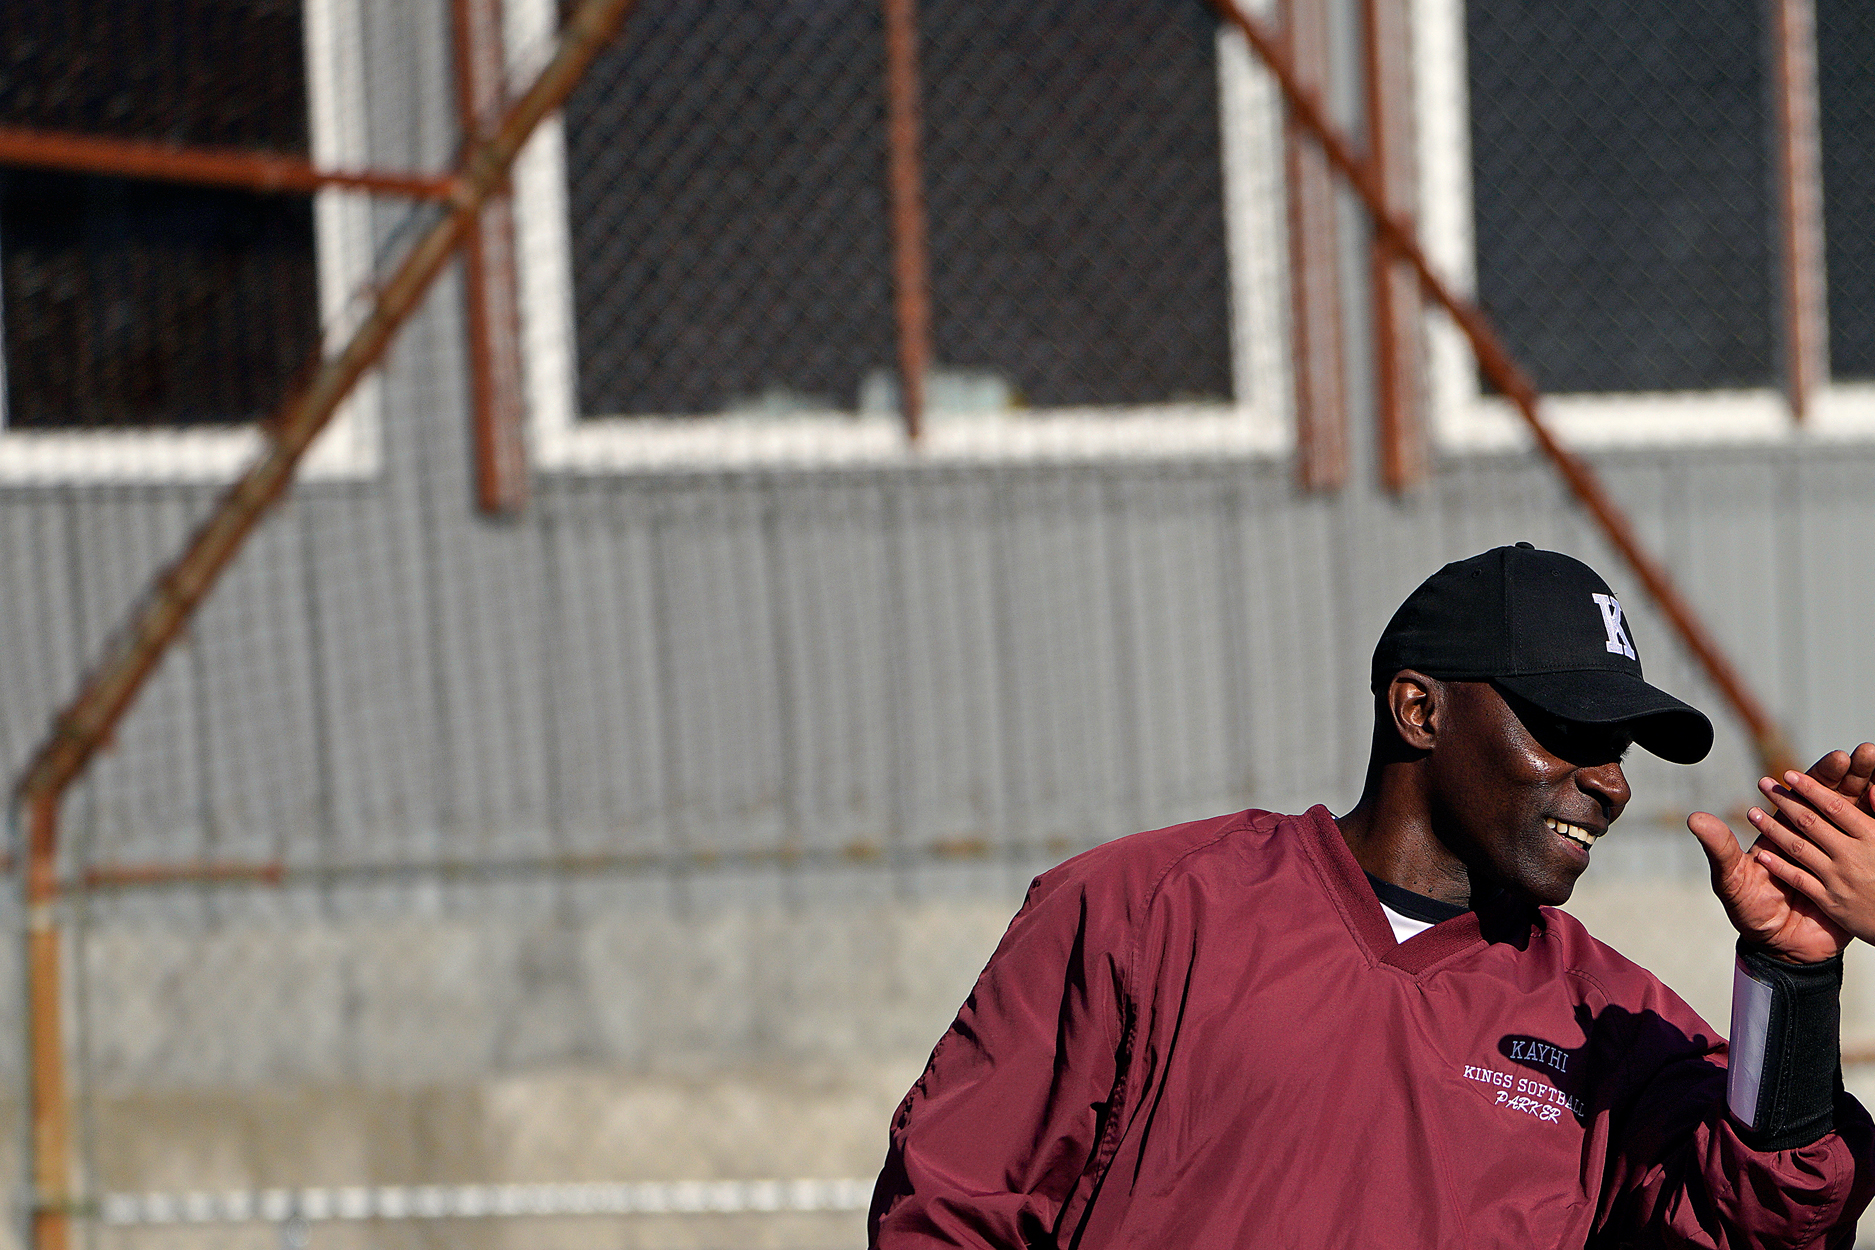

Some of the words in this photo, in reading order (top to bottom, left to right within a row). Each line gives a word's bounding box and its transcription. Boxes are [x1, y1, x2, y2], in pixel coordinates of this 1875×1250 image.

[1592, 592, 1636, 661] K
[1510, 1040, 1569, 1073] KAYHI
[1463, 1065, 1514, 1088] KINGS
[1517, 1078, 1585, 1117] SOFTBALL
[1494, 1090, 1561, 1124] PARKER
